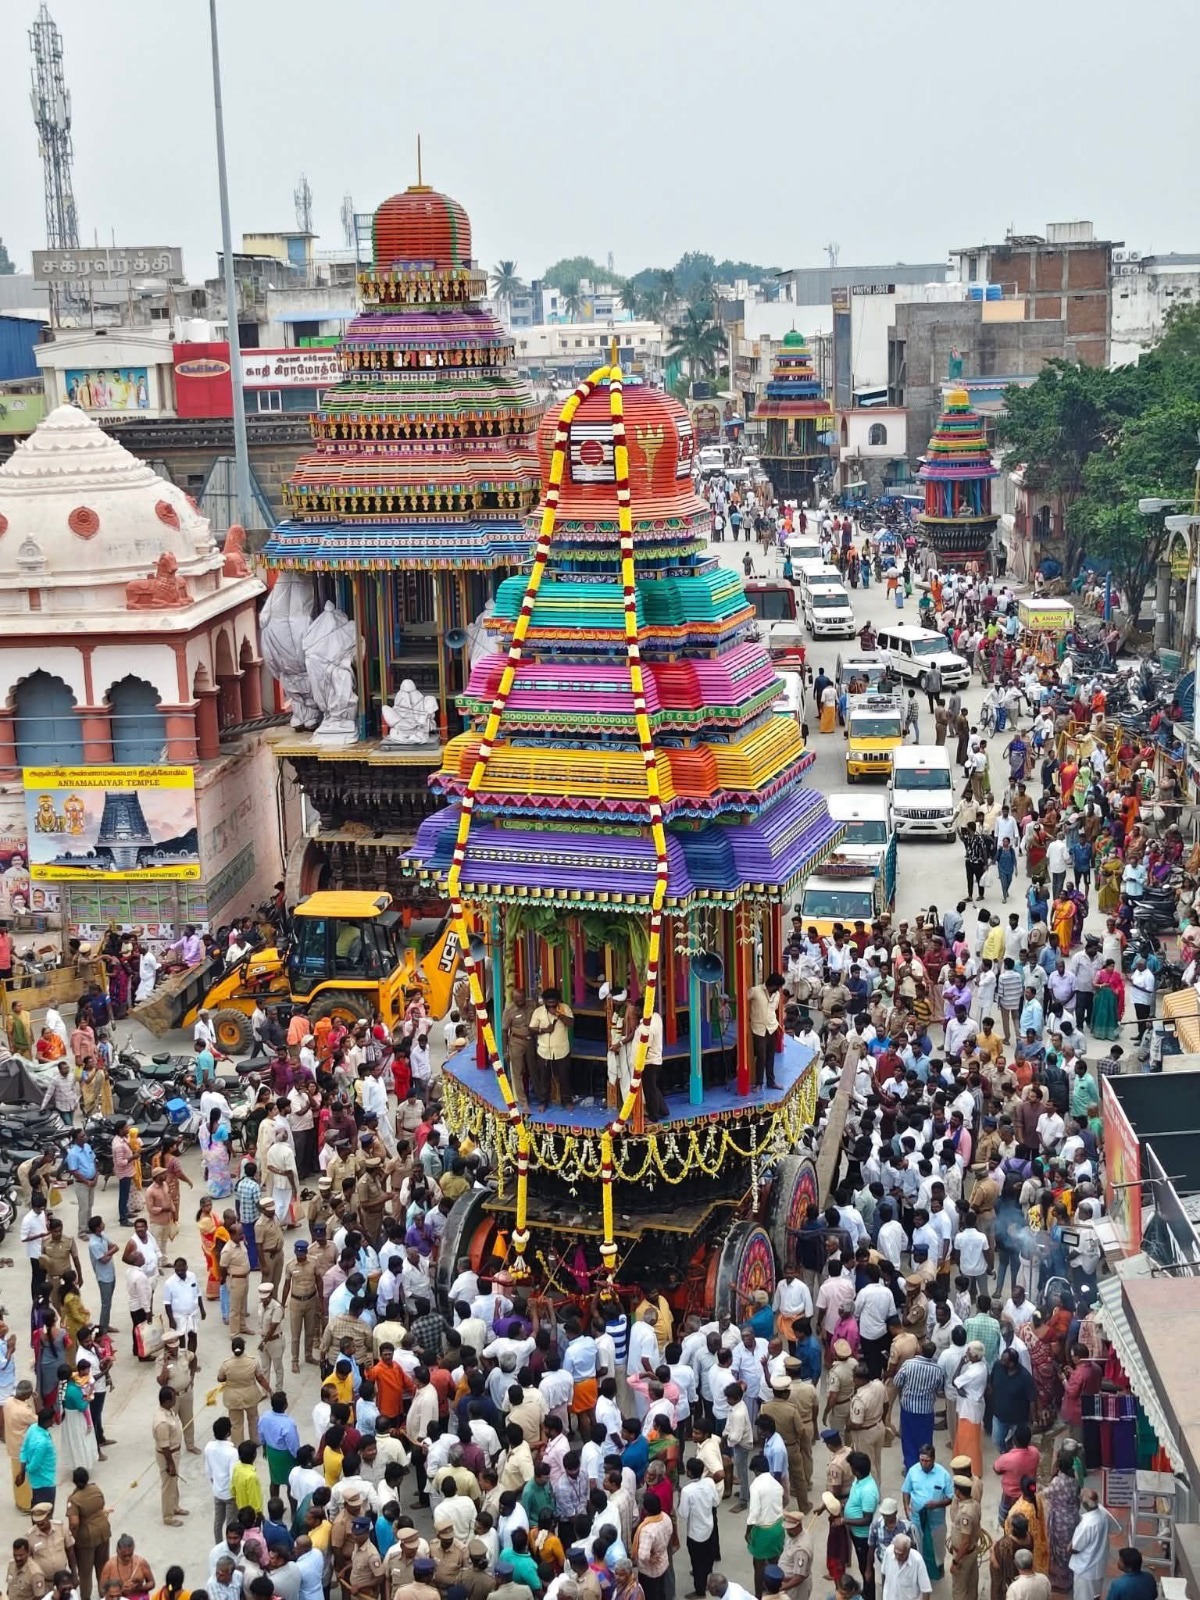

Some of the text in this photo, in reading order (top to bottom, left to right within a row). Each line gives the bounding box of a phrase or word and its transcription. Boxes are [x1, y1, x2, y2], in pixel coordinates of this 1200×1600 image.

[57, 779, 161, 787] ANNAMALAIYAR TEMPLE
[441, 931, 459, 973] JCB
